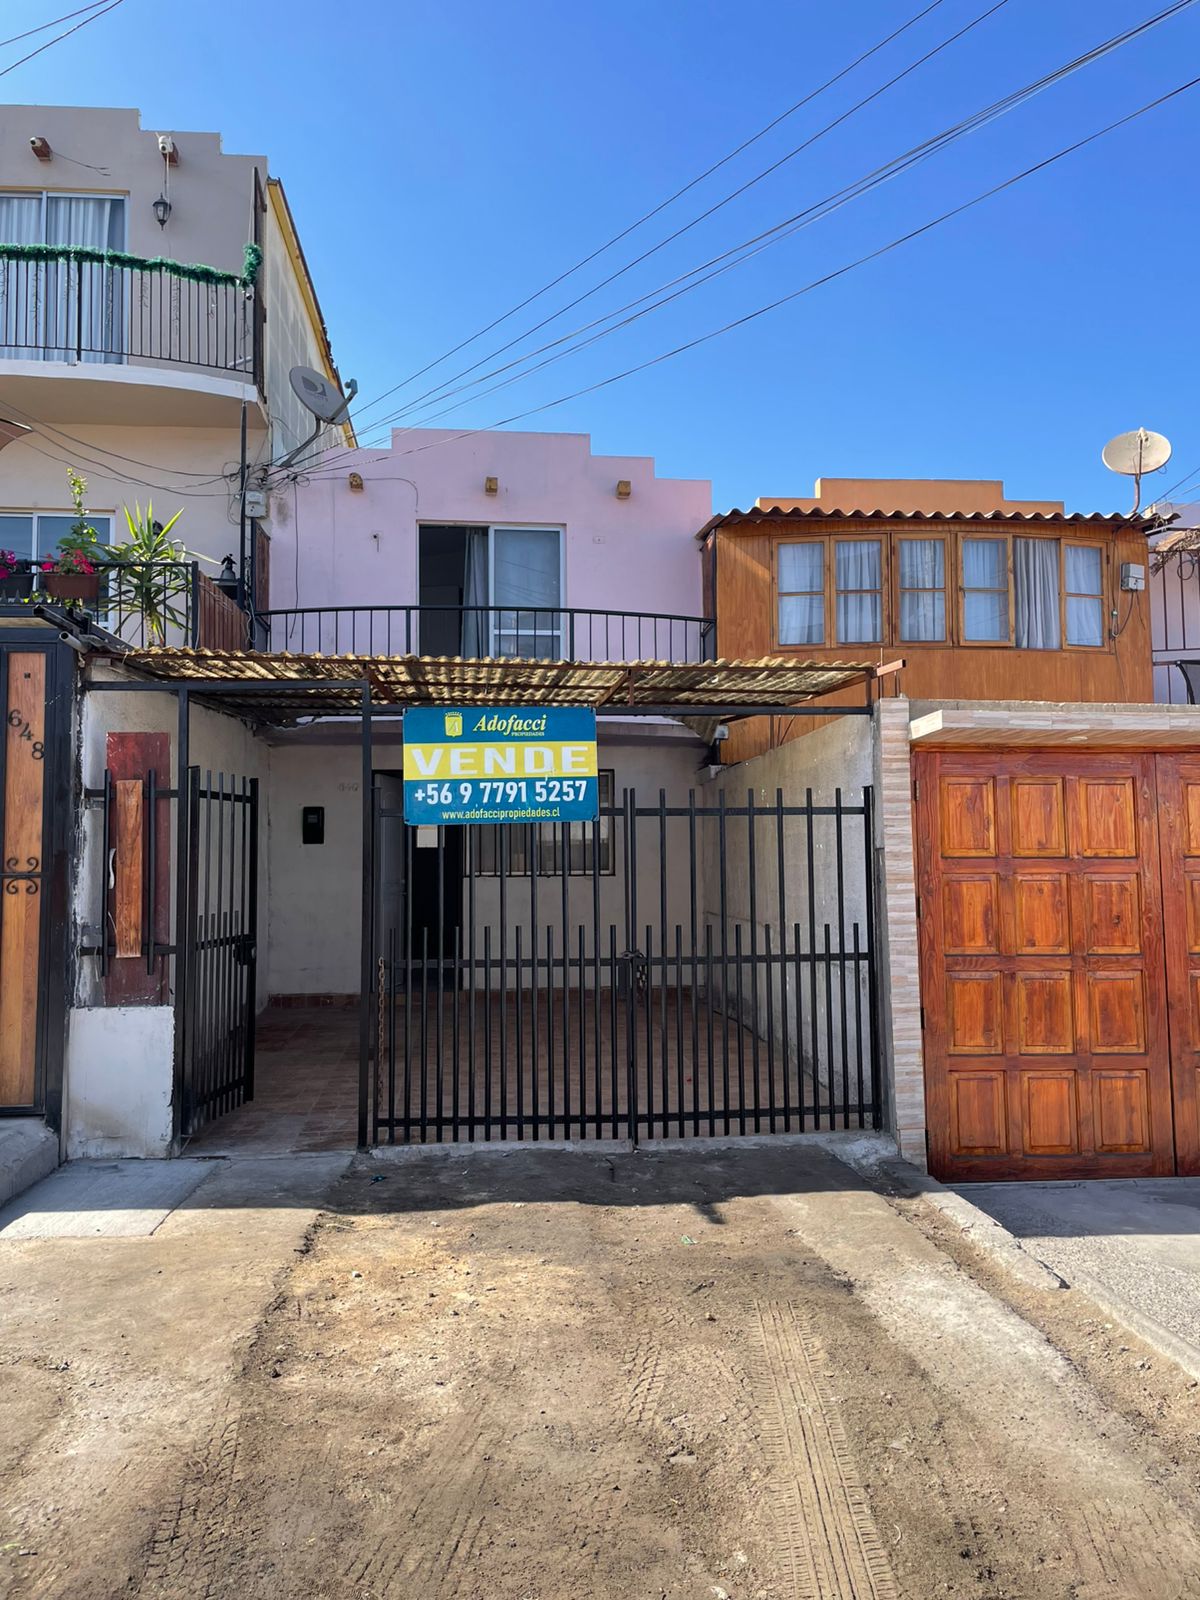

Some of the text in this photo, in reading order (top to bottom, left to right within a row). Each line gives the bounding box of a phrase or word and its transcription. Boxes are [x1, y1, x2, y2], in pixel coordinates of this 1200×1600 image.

[8, 709, 44, 760] 648
[473, 714, 547, 735] Adofacci
[411, 746, 590, 776] VENDE
[414, 780, 587, 805] +56 9 7791 5257
[441, 807, 560, 820] www.adofaccipropiedades.cl
